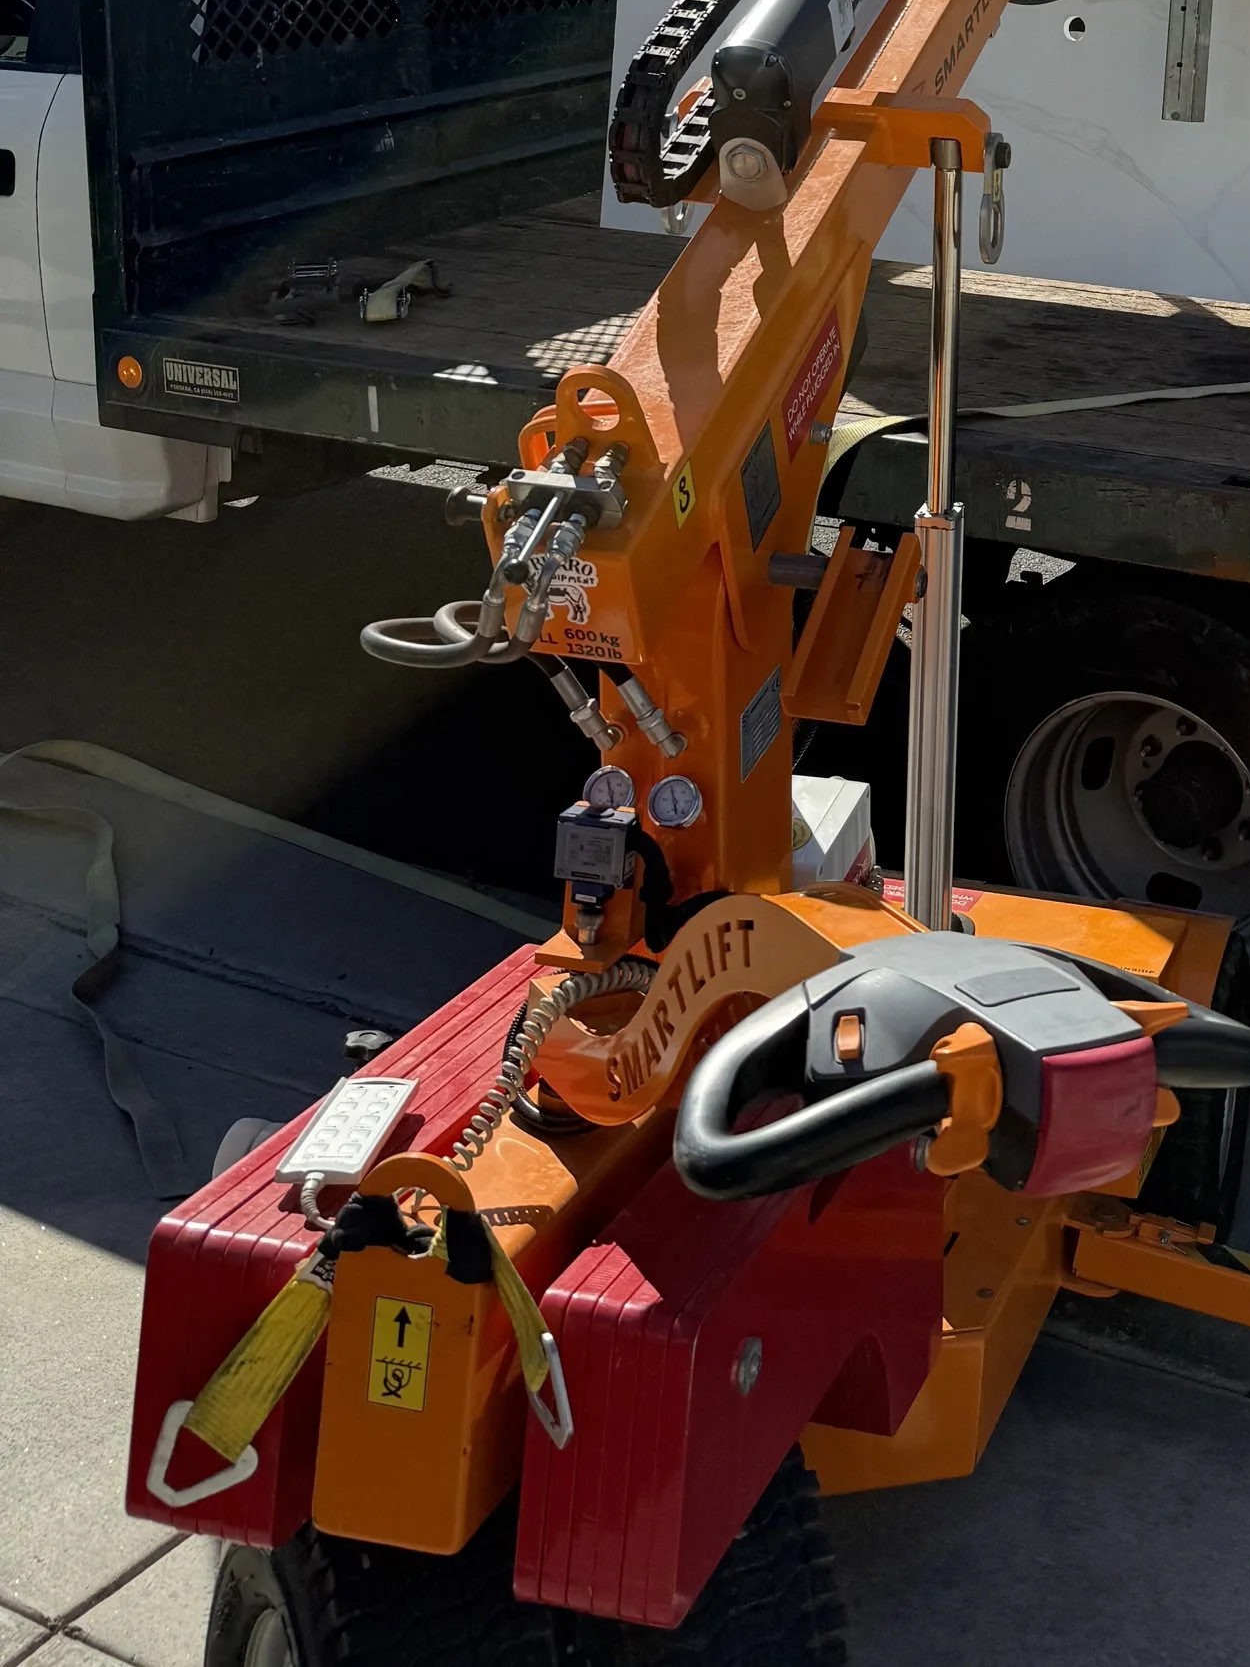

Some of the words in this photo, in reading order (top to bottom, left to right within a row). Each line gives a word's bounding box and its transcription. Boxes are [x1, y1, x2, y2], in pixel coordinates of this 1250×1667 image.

[165, 362, 237, 390] UNIVERSAL
[788, 399, 799, 423] DO
[799, 372, 811, 401] NOT
[812, 325, 837, 376] OPERATE
[788, 404, 807, 440] WHILE
[806, 352, 834, 408] PLUGGED
[1005, 479, 1032, 531] 2
[540, 632, 558, 644] LL
[564, 628, 597, 641] 600
[600, 632, 620, 647] kg
[567, 643, 606, 656] 1320
[607, 646, 622, 659] lb
[606, 919, 755, 1102] SMARTLIFT
